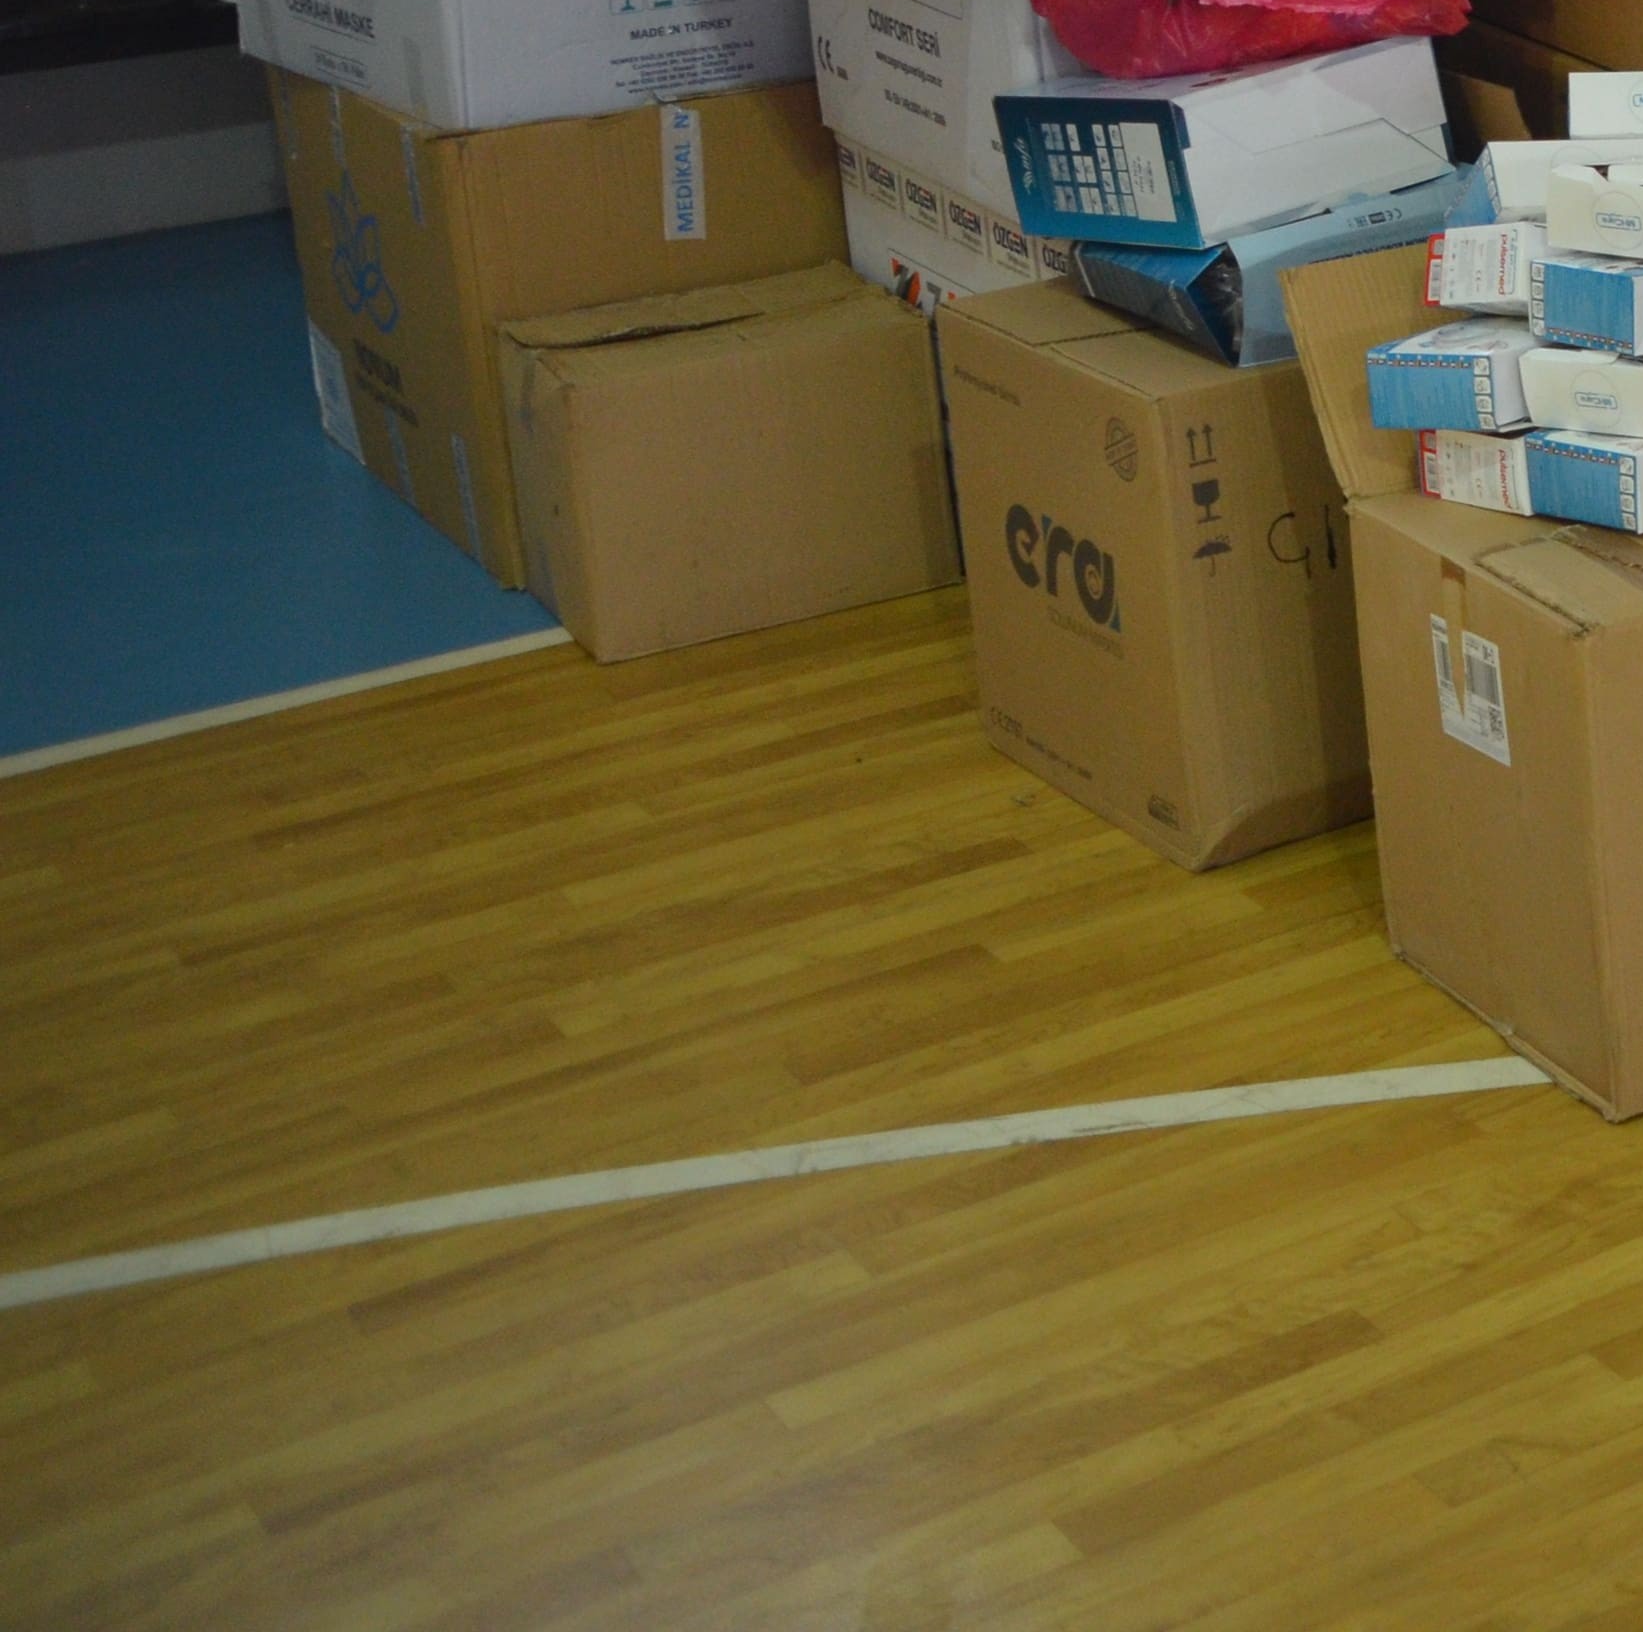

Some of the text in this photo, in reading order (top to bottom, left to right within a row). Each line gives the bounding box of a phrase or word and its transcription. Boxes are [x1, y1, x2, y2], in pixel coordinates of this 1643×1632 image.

[333, 6, 376, 39] MASKE
[629, 26, 665, 41] MADE
[683, 17, 734, 34] TURKEY
[867, 6, 942, 60] COMFORT SERİ
[676, 140, 697, 233] MEDİKAL
[1004, 503, 1121, 626] era
